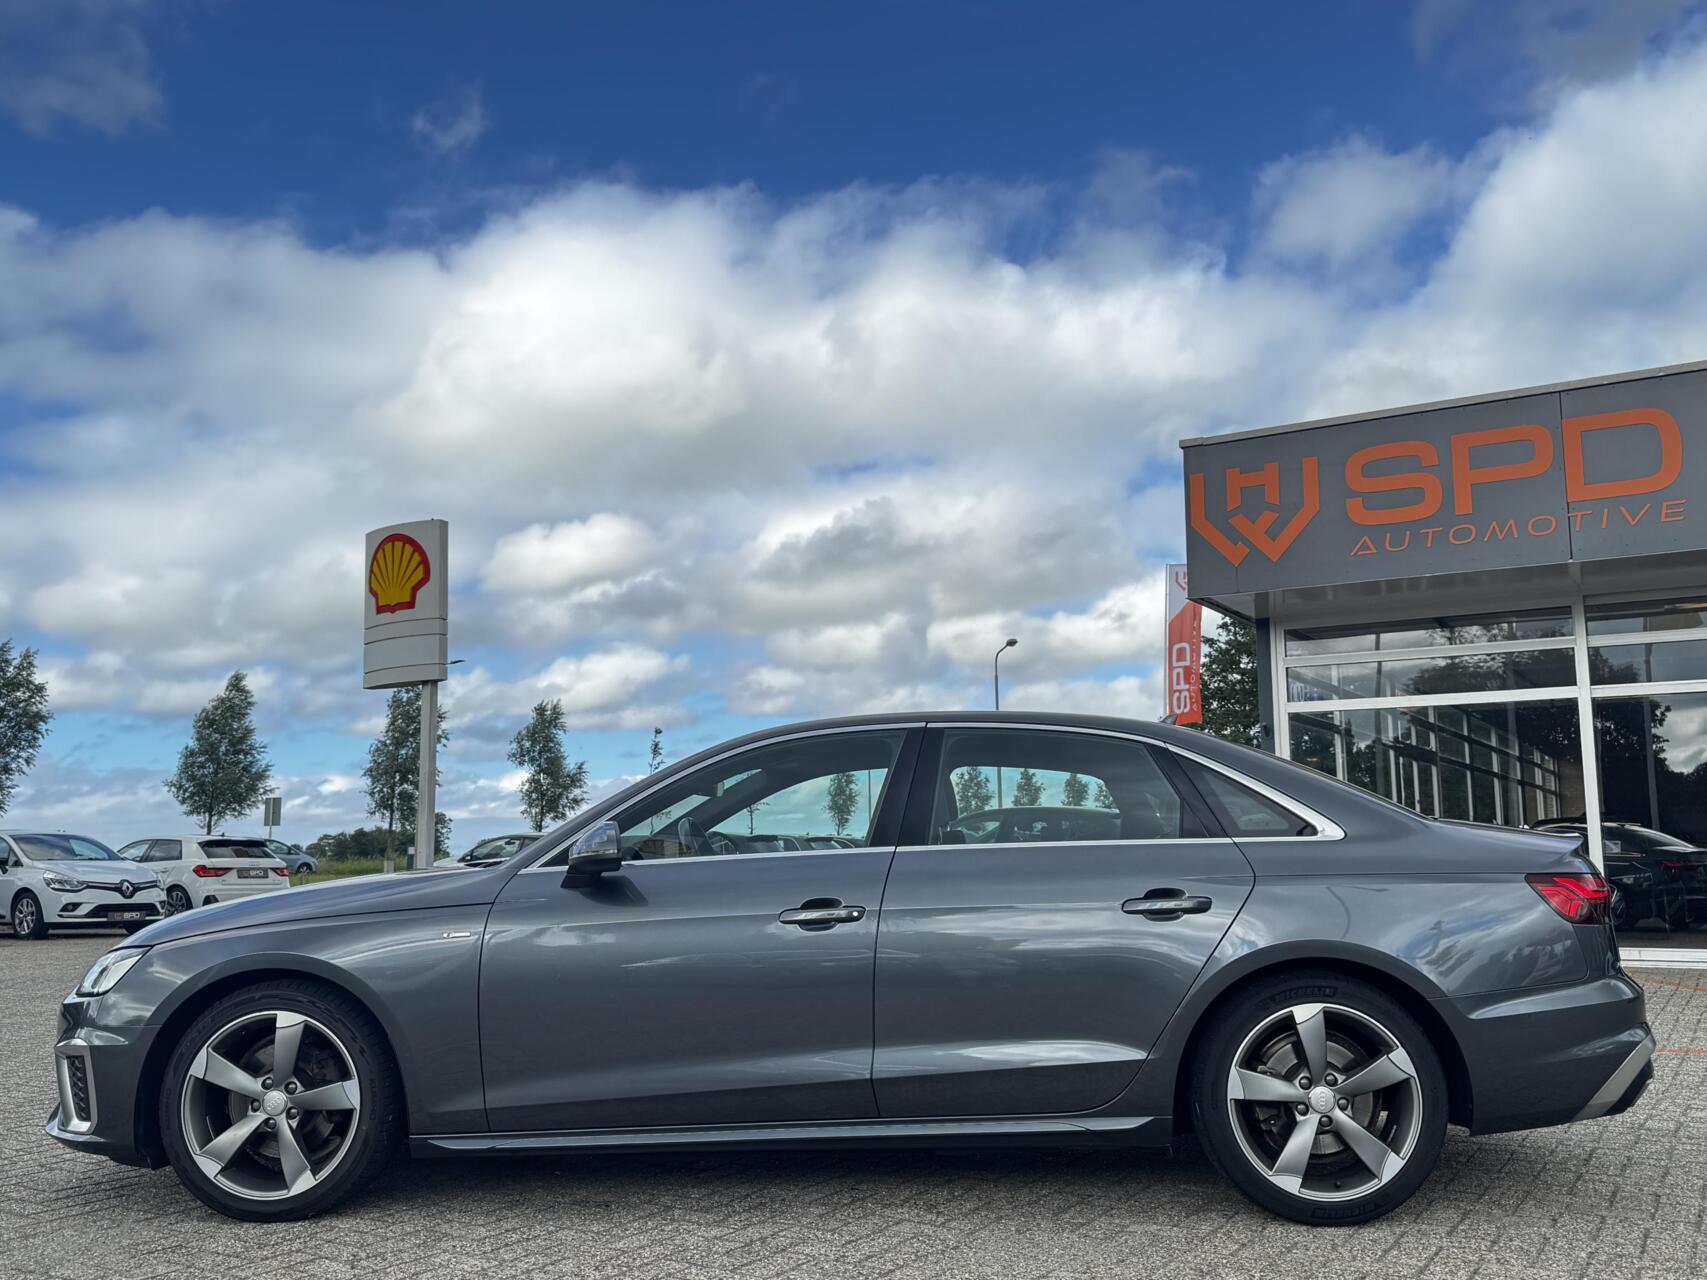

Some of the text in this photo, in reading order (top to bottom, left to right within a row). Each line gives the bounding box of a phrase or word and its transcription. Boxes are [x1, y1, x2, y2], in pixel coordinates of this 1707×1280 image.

[1346, 408, 1683, 526] SPD
[1350, 499, 1687, 557] AUTOMOTIVE
[1173, 642, 1191, 714] SPD
